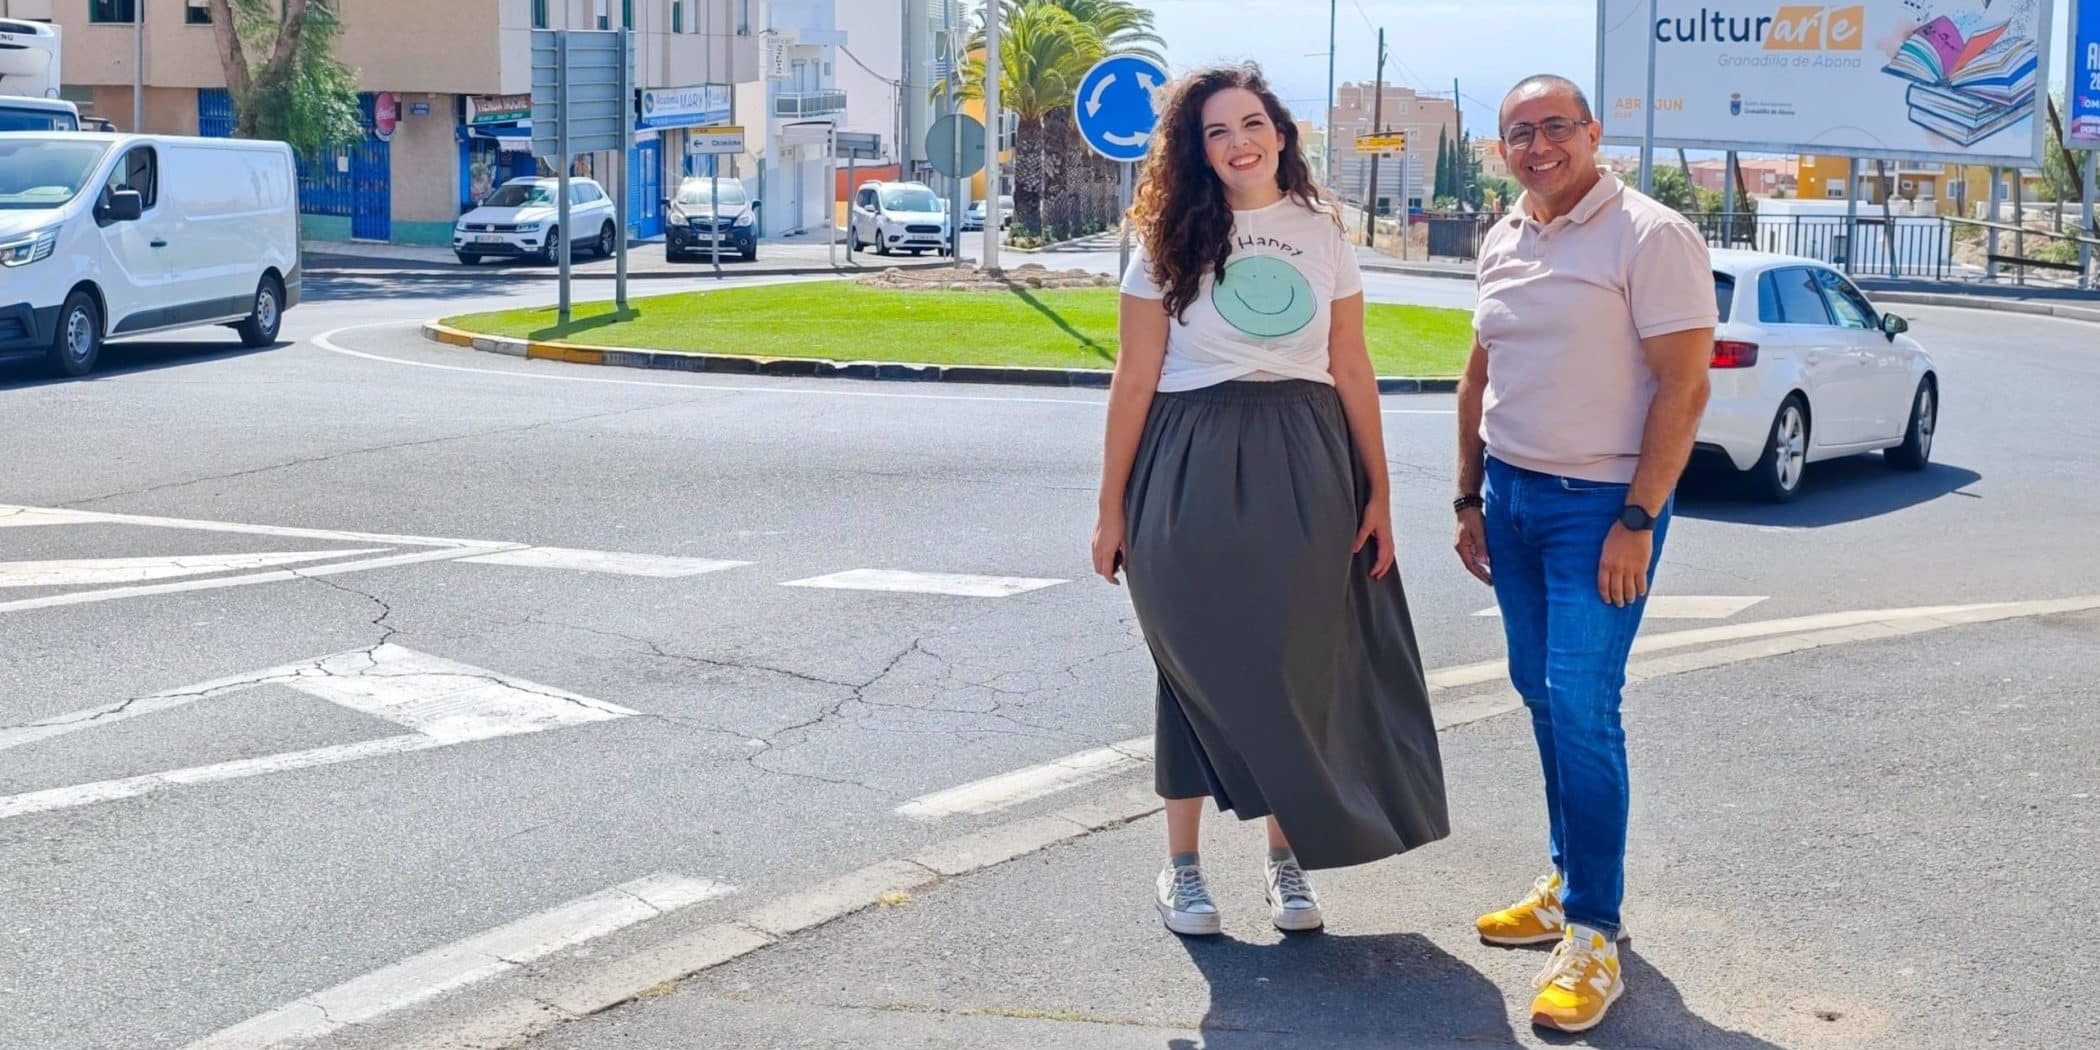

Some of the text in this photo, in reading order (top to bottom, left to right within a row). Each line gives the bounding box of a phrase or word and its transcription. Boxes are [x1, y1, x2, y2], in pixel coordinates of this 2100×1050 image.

[1717, 53, 1862, 68] Granadilla de Abona
[1615, 98, 1684, 111] ABR JUN
